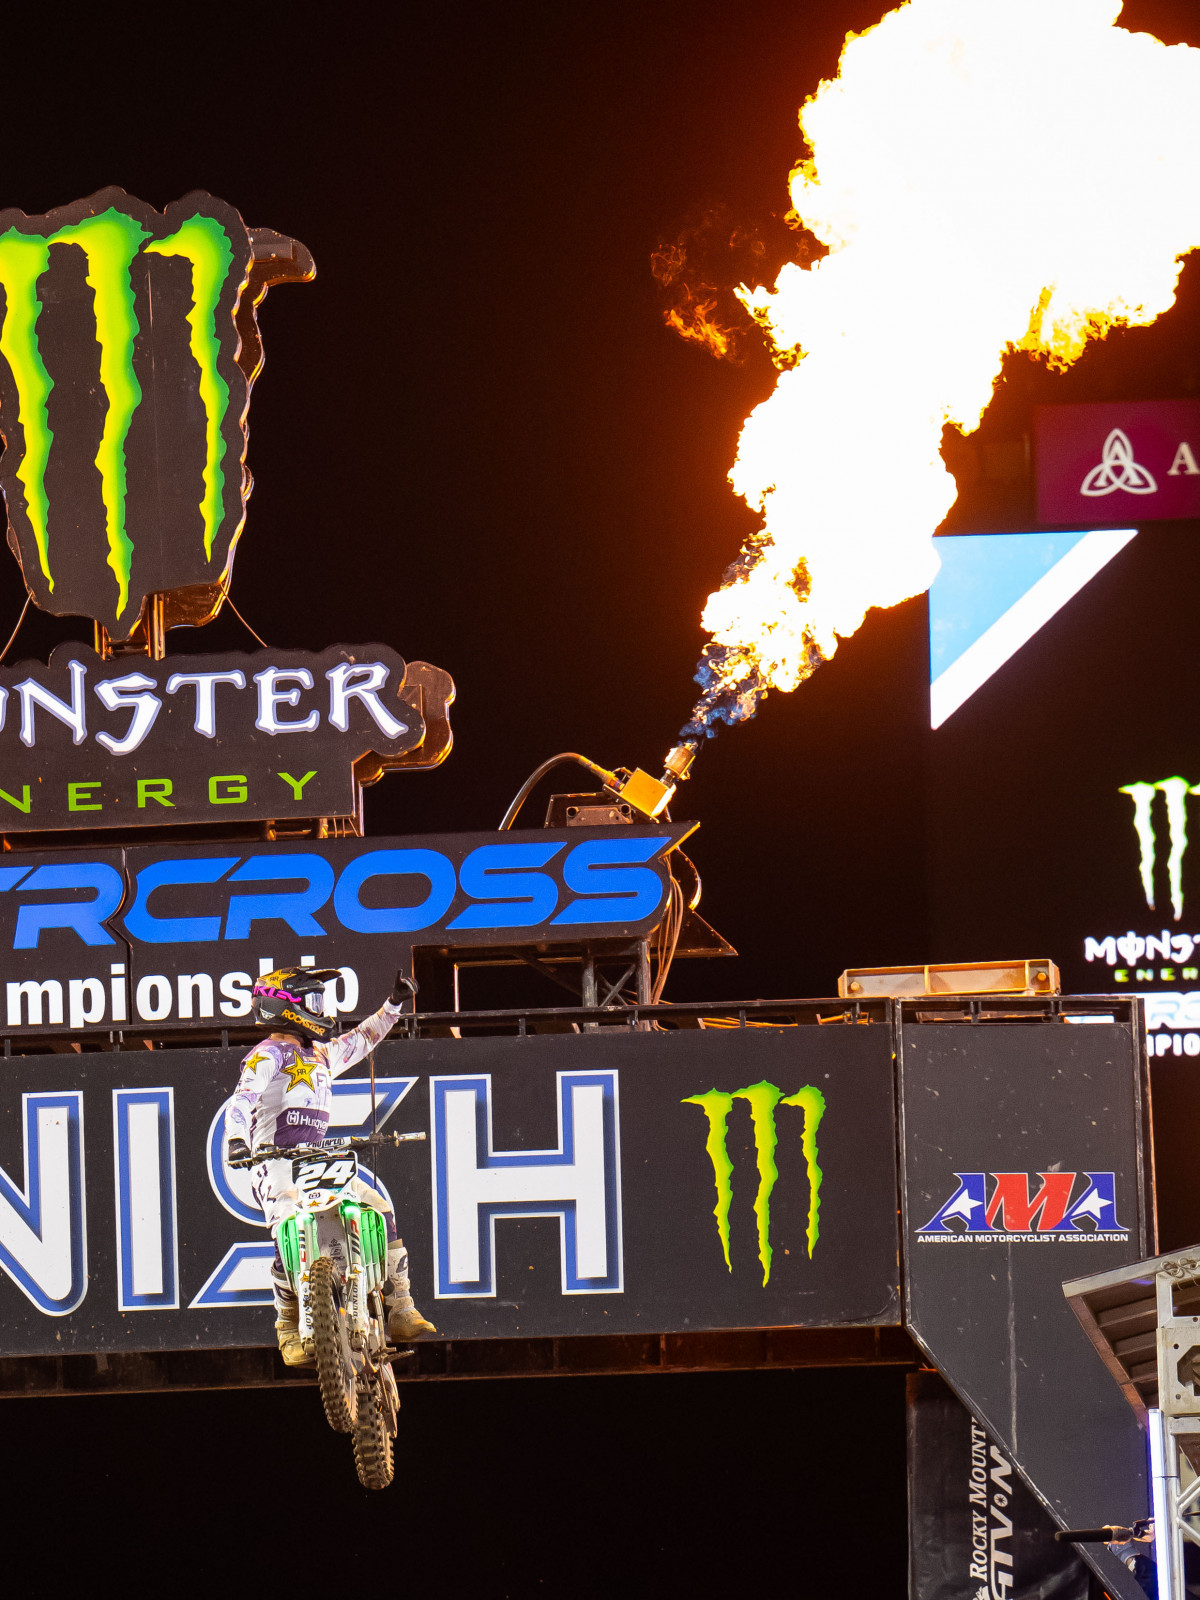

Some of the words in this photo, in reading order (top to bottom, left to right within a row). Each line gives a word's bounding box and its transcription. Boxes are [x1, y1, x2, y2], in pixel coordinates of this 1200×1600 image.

[281, 1009, 326, 1037] ROCKSTAR
[295, 1160, 355, 1192] 24
[914, 1171, 1130, 1232] AMA
[917, 1234, 973, 1243] AMERICAN
[975, 1233, 1056, 1243] MOTORCYCLIST
[1058, 1233, 1129, 1242] ASSOCIATION
[969, 1416, 987, 1508] MOUNT
[970, 1510, 988, 1582] ROCKY
